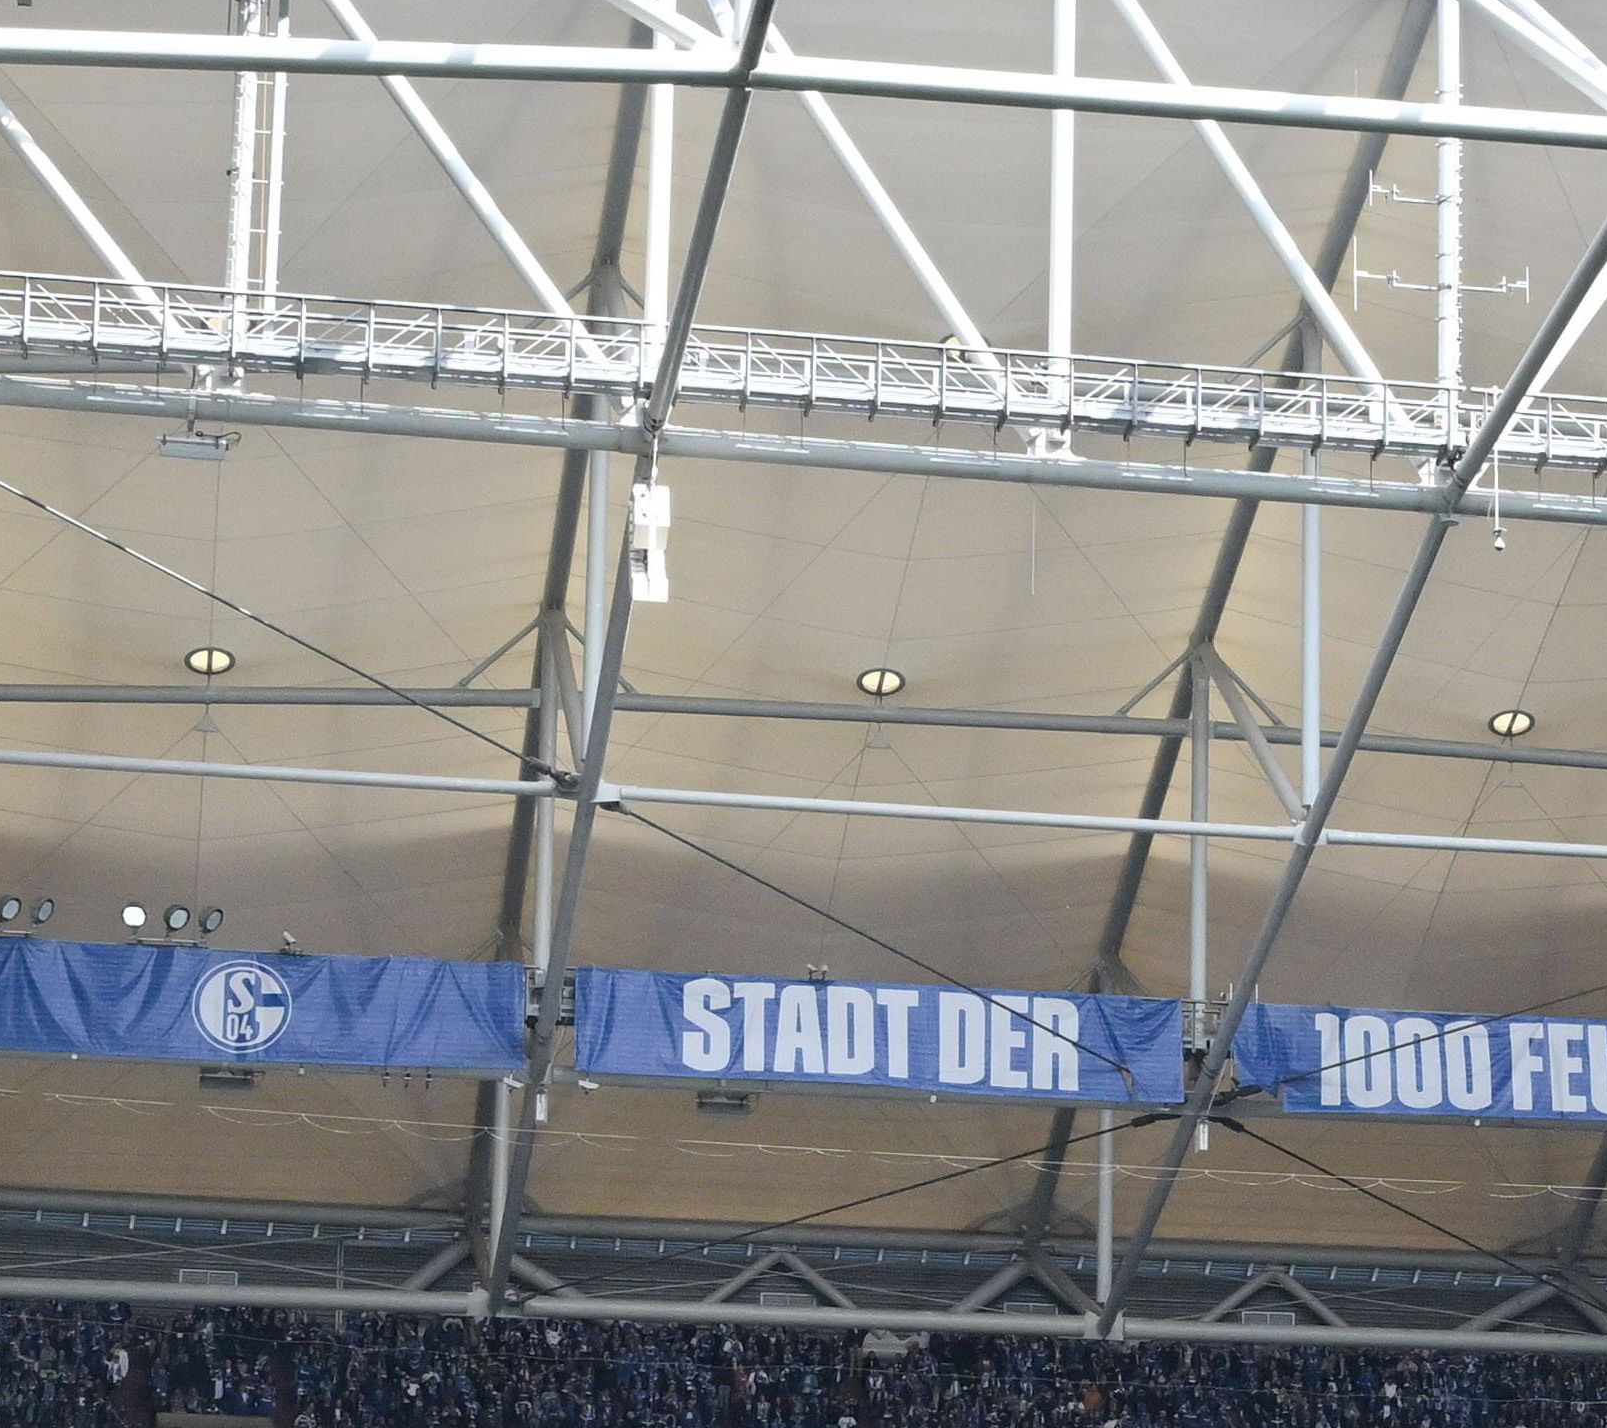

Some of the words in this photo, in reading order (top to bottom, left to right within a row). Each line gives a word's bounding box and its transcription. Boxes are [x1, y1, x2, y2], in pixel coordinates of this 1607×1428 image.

[681, 977, 931, 1081] STADT
[939, 992, 1081, 1092] DER
[1315, 1012, 1489, 1110] 1000
